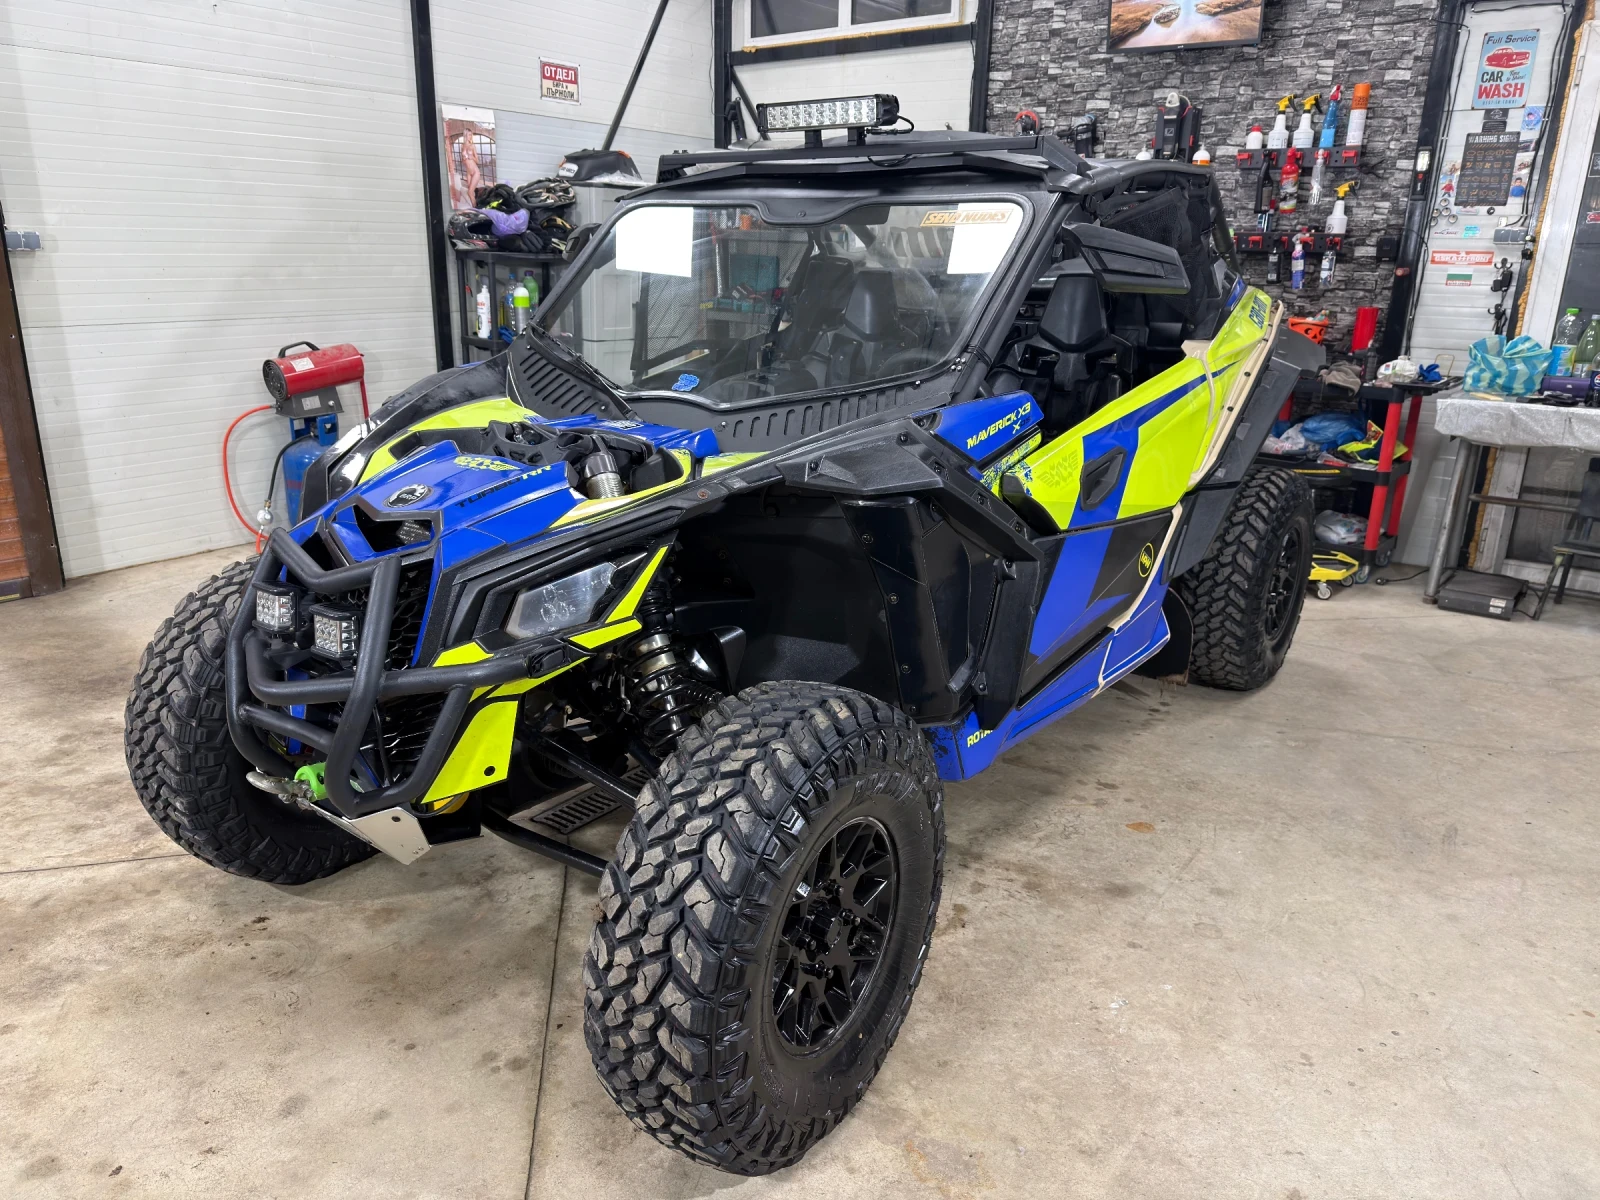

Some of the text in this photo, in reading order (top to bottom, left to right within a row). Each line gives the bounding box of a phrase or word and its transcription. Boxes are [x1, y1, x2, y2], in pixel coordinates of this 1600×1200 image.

[1486, 34, 1536, 45] Full Service
[544, 65, 575, 82] ОТДЕЛ
[1480, 70, 1504, 83] CAR
[1477, 82, 1526, 100] WASH
[1468, 133, 1518, 144] WARNING SIGNS
[927, 211, 1007, 224] SEND NUDES
[966, 401, 1031, 450] MAVERICK X3
